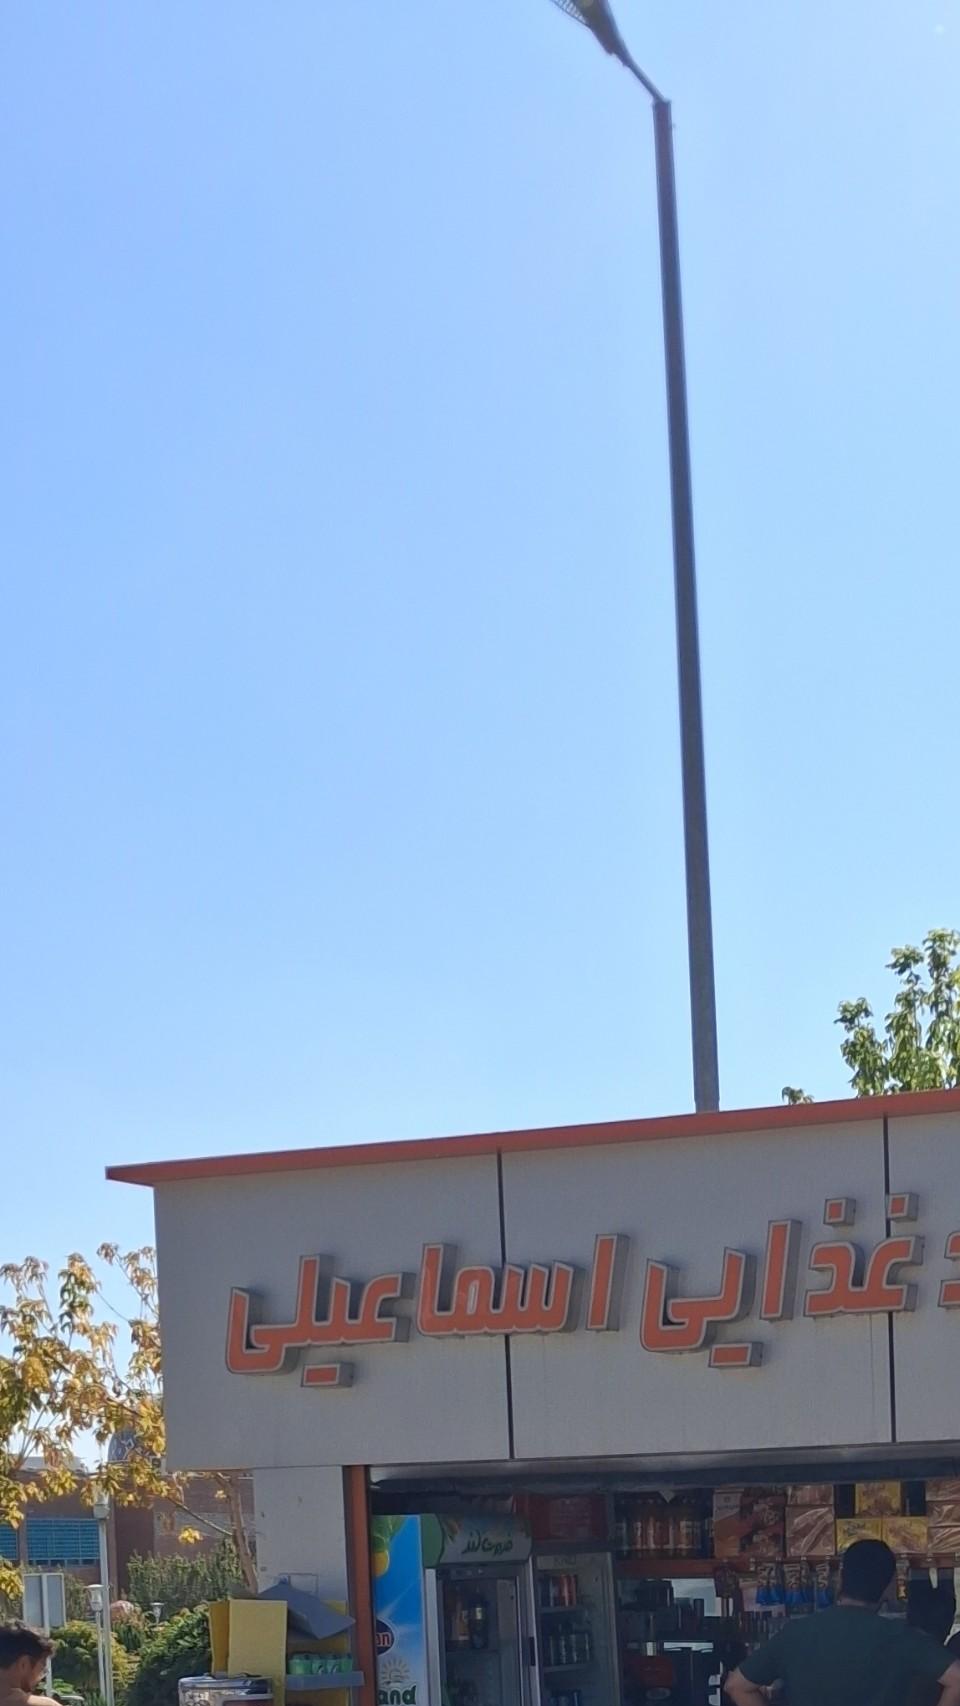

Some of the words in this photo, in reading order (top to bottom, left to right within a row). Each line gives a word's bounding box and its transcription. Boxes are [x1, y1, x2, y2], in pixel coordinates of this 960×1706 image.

[224, 1233, 630, 1389] اسماعیلی
[638, 1191, 926, 1369] غذایی
[377, 1685, 417, 1706] and
